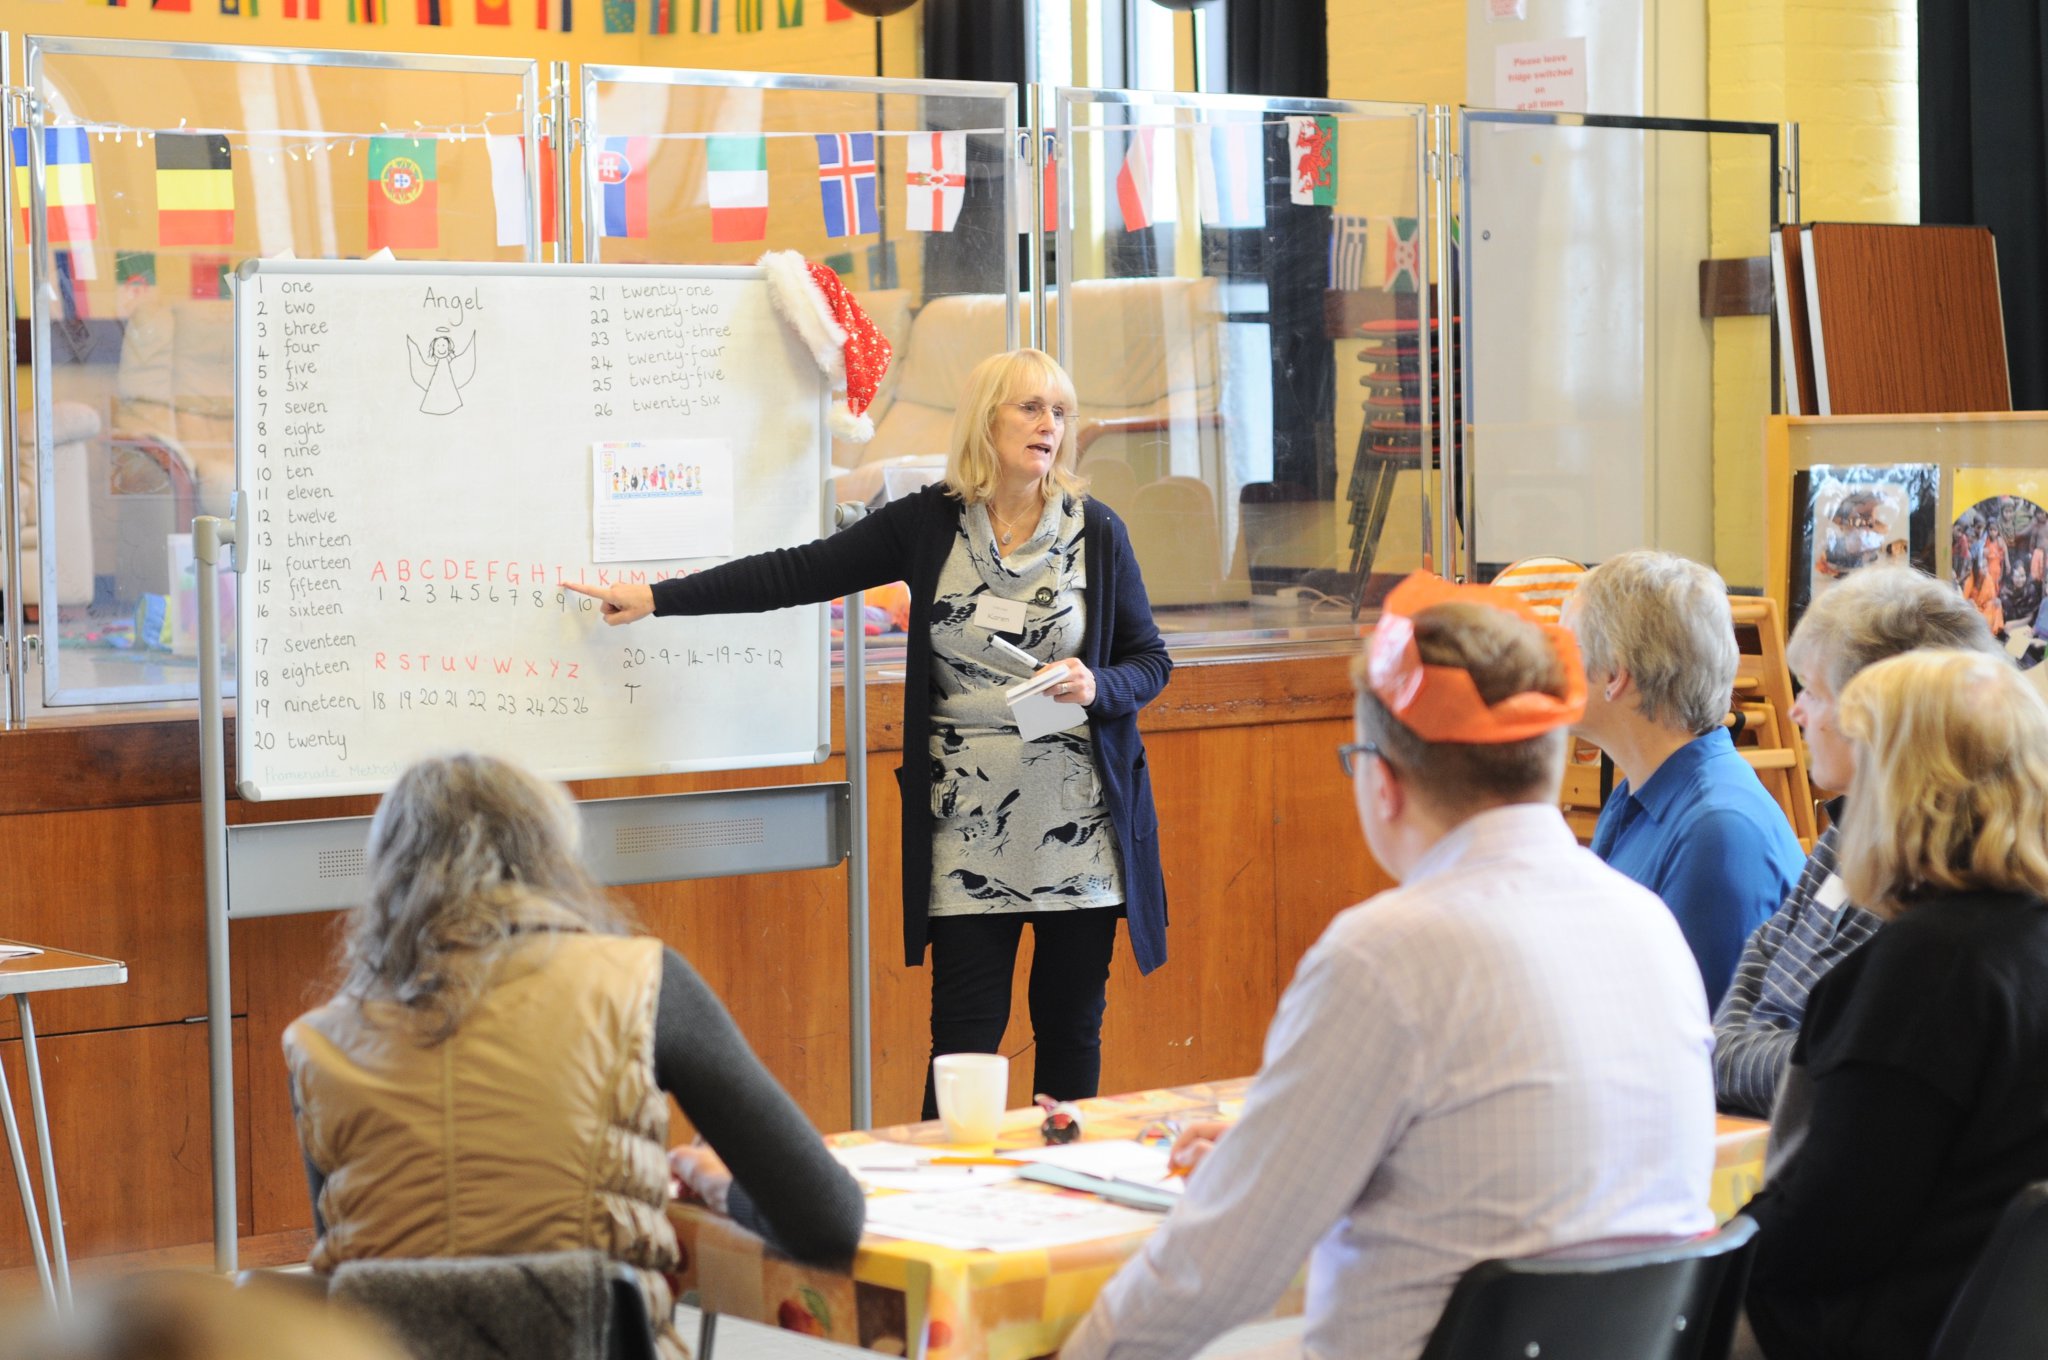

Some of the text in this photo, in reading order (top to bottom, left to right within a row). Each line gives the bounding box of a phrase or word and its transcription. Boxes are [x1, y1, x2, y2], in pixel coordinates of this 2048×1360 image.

[258, 276, 314, 293] 1 one
[590, 284, 714, 304] 21 twenty-one
[257, 301, 315, 316] 2 two
[423, 287, 483, 327] Angel
[591, 303, 719, 327] 22 twenty-two
[258, 320, 328, 337] 3 three
[592, 323, 731, 348] 23 twenty-three
[258, 338, 320, 360] 4 four
[592, 346, 724, 370] 24 twenty-four
[258, 360, 317, 380] 5 five
[593, 367, 724, 392] 25 twenty-five
[258, 379, 309, 397] 6 six
[258, 402, 328, 416] 7 seven
[594, 396, 720, 416] 26 twenty-six
[258, 421, 325, 445] 8 eight
[258, 444, 320, 458] 9 nine
[257, 466, 313, 481] 10 ten
[259, 485, 333, 500] 11 eleven
[258, 509, 336, 523] 12 twelve
[258, 532, 351, 547] 13 thirteen
[258, 556, 351, 577] 14 fourteen
[371, 561, 387, 582] A
[398, 559, 410, 582] B
[420, 560, 434, 579] C
[444, 559, 458, 580] D
[465, 560, 477, 579] E
[488, 561, 498, 581] F
[507, 562, 519, 585] G
[532, 564, 544, 583] H
[598, 568, 609, 585] K
[619, 569, 625, 584] L
[631, 570, 645, 584] M
[258, 577, 341, 600] 15 fifteen
[378, 584, 592, 612] 1 2 3 4 5 6 7 8 9 10
[258, 602, 343, 618] 16 sixteen
[256, 633, 356, 655] 17 seventeen
[256, 661, 349, 687] 18 eighteen
[376, 652, 578, 678] R S T U V W X Y Z
[373, 688, 588, 716] 18 19 20 21 22 23 24 25 26
[624, 683, 641, 704] T
[256, 694, 360, 718] 19 nineteen
[254, 730, 347, 760] 20 twenty
